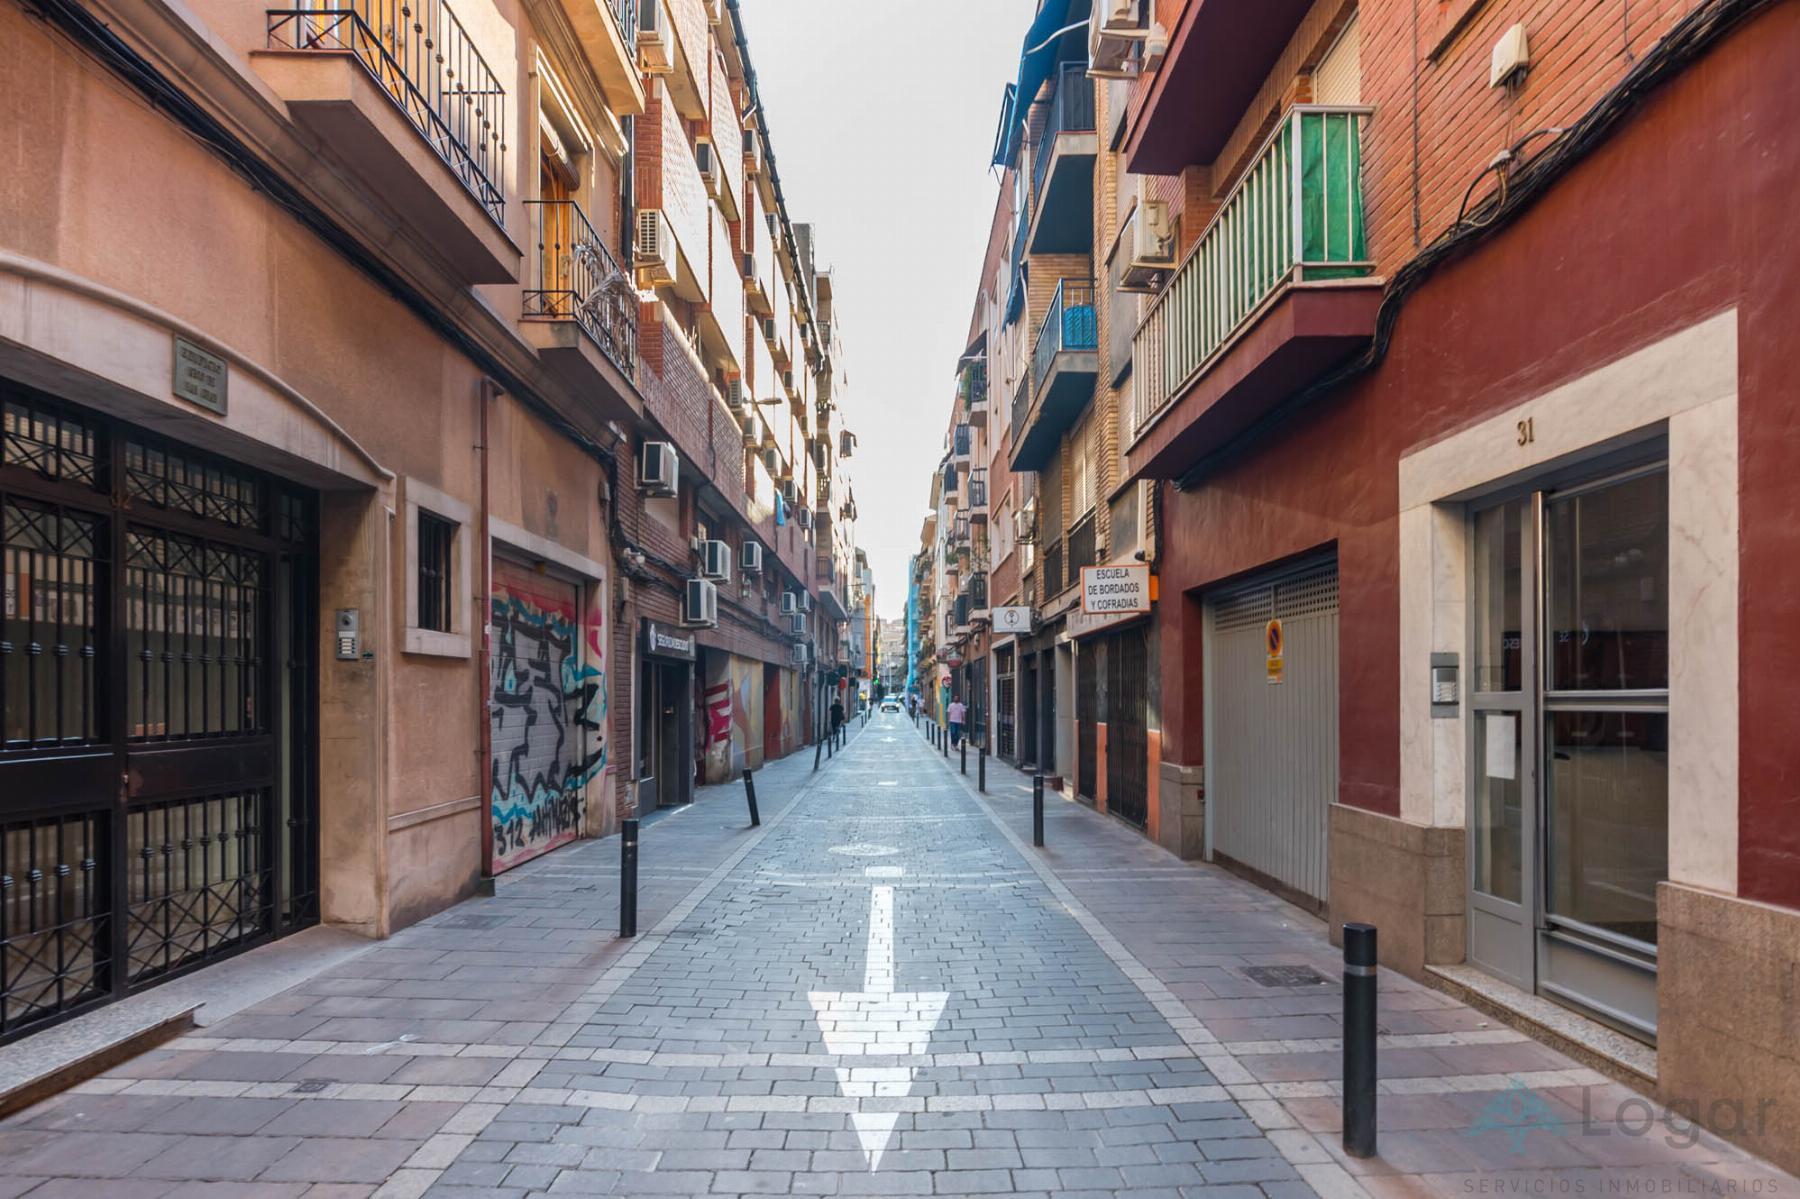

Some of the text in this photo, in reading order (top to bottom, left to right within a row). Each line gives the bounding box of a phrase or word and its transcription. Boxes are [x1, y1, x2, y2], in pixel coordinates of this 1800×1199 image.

[1517, 416, 1535, 447] 31
[1096, 568, 1130, 580] ESCUELA
[1088, 582, 1140, 595] DE BORDADOS
[1091, 598, 1138, 610] Y COFRADIAS
